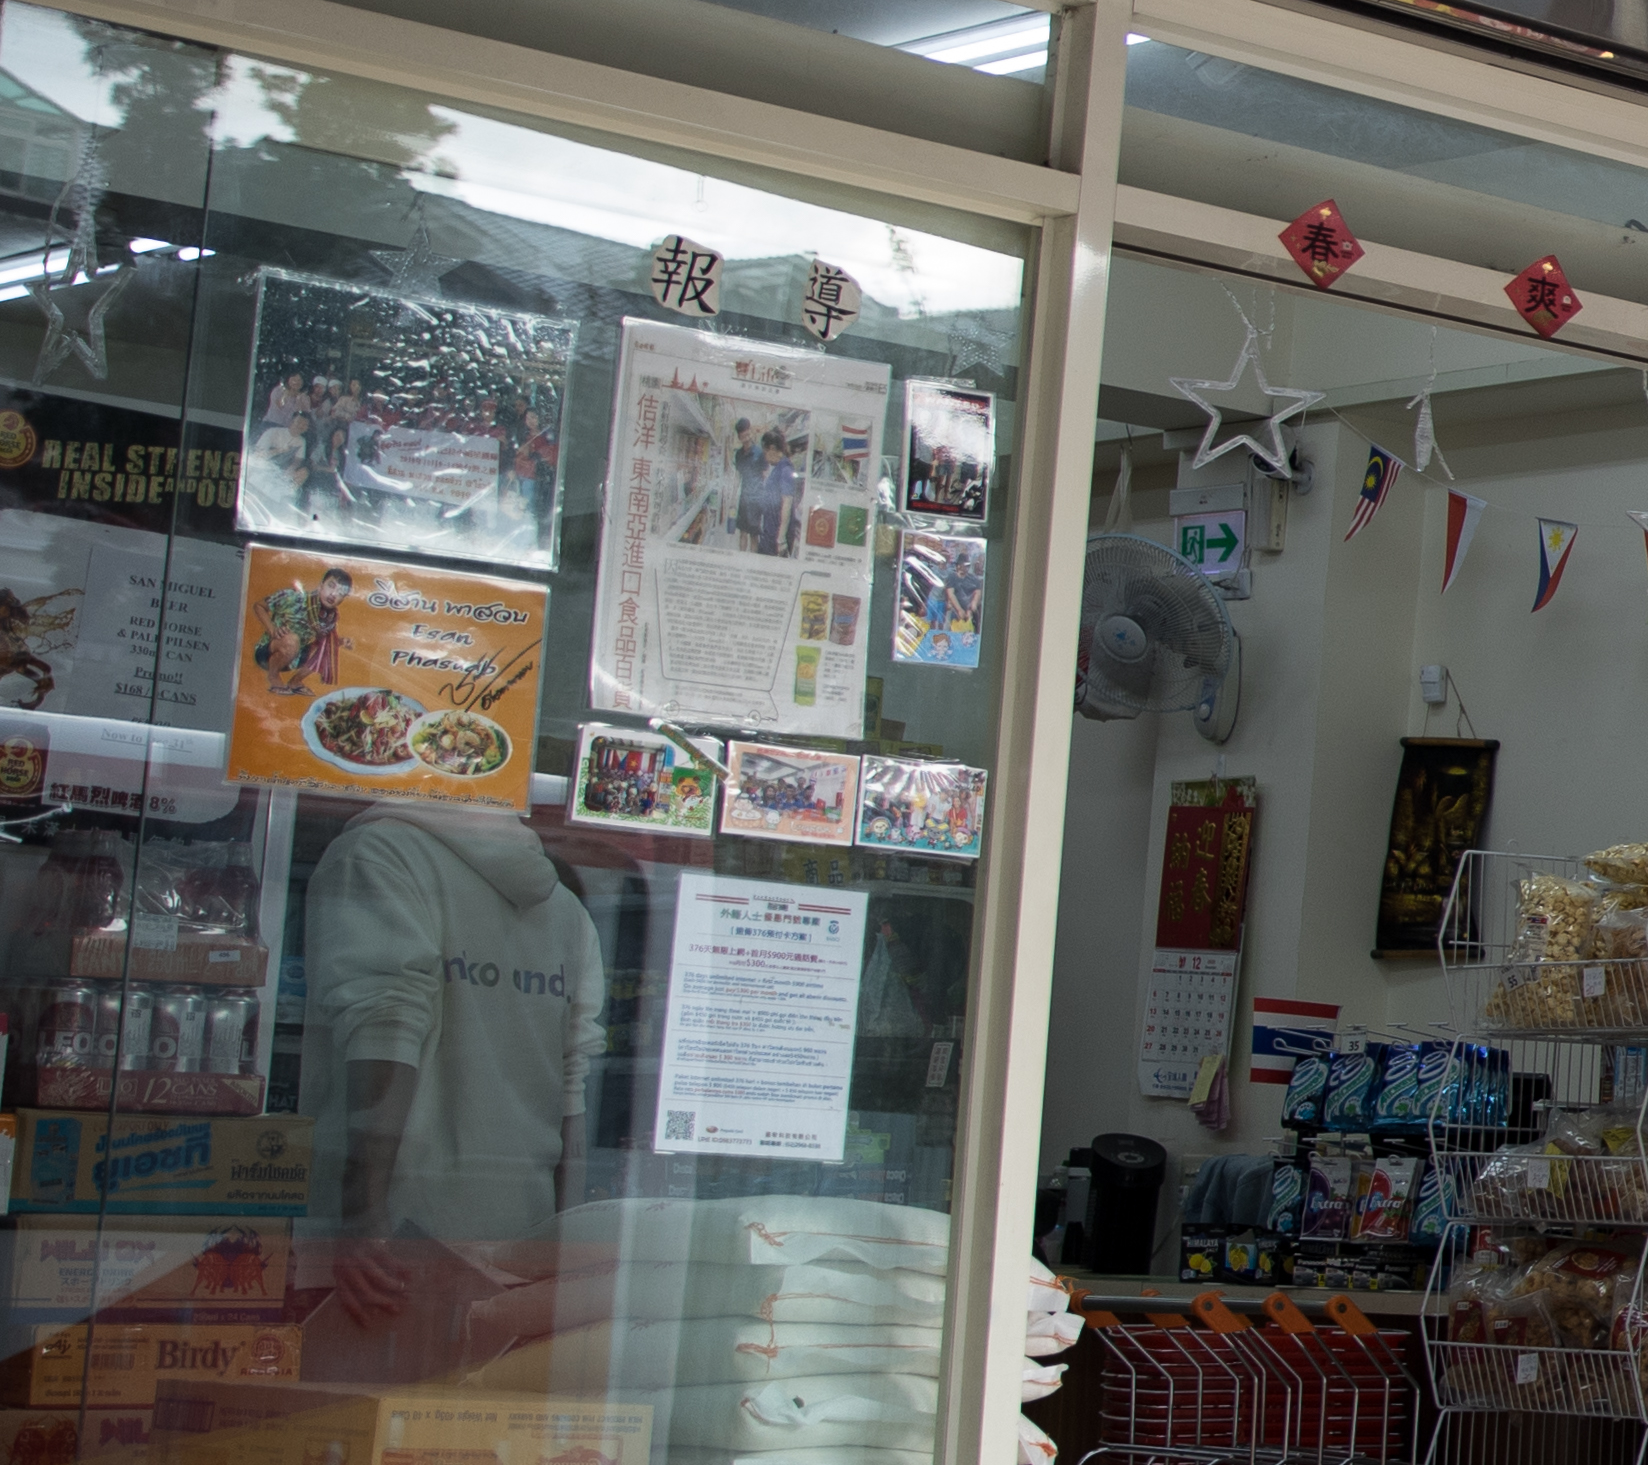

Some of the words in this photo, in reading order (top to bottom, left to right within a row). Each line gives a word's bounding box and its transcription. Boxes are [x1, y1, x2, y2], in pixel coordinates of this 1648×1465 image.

[1301, 221, 1340, 264] 春
[1524, 277, 1559, 317] 爽
[651, 235, 716, 315] 報
[803, 258, 857, 339] 導
[42, 439, 117, 473] REAL
[58, 470, 164, 504] INSIDE
[129, 575, 155, 591] SAN
[150, 599, 189, 614] BER
[129, 616, 156, 630] RED
[160, 620, 202, 635] ORSE
[166, 650, 194, 663] CAN
[155, 1339, 238, 1377] Birdy
